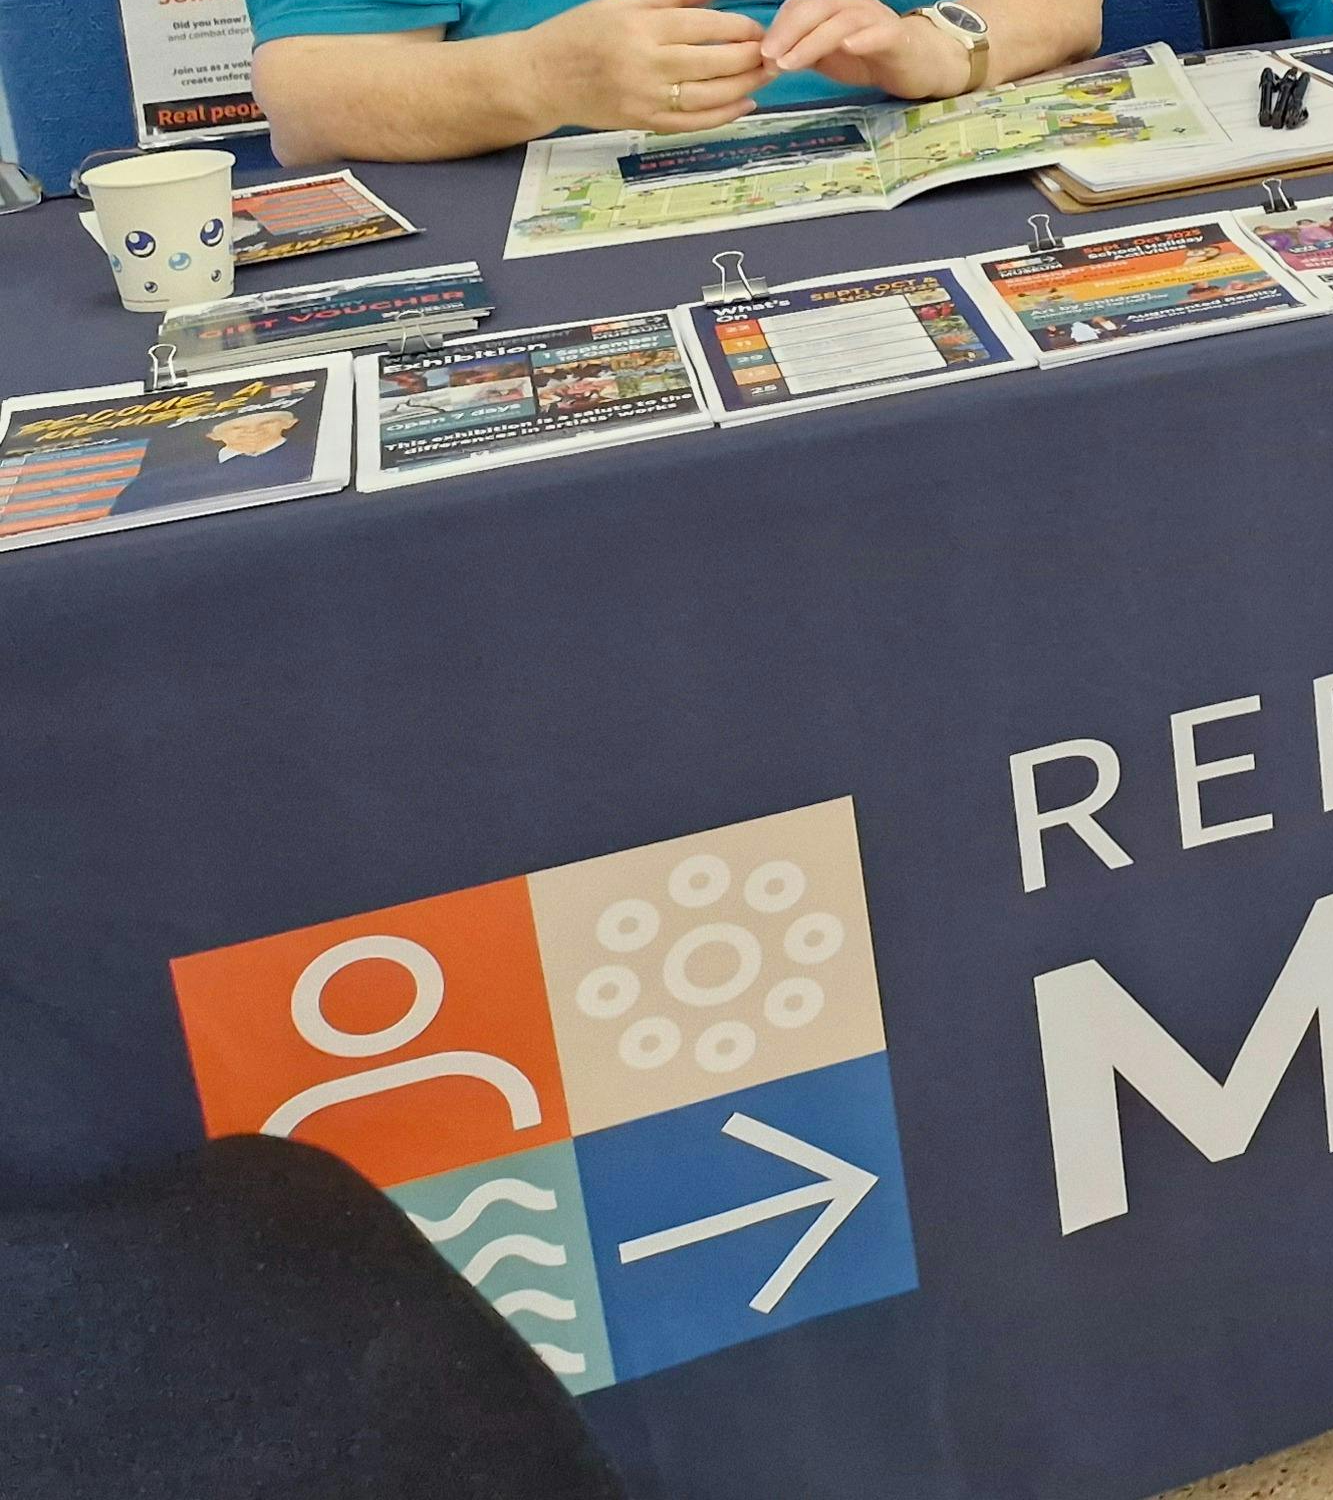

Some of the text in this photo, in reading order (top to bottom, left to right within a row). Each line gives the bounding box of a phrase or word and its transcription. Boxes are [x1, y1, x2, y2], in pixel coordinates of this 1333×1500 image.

[158, 105, 206, 126] Real
[287, 290, 465, 323] VOUCHER
[713, 299, 790, 317] What's
[715, 314, 749, 324] On
[1126, 299, 1223, 322] Augmented
[383, 342, 548, 375] Exhibition
[386, 402, 523, 433] Open days
[384, 438, 427, 452] This
[431, 420, 533, 443] exhibition
